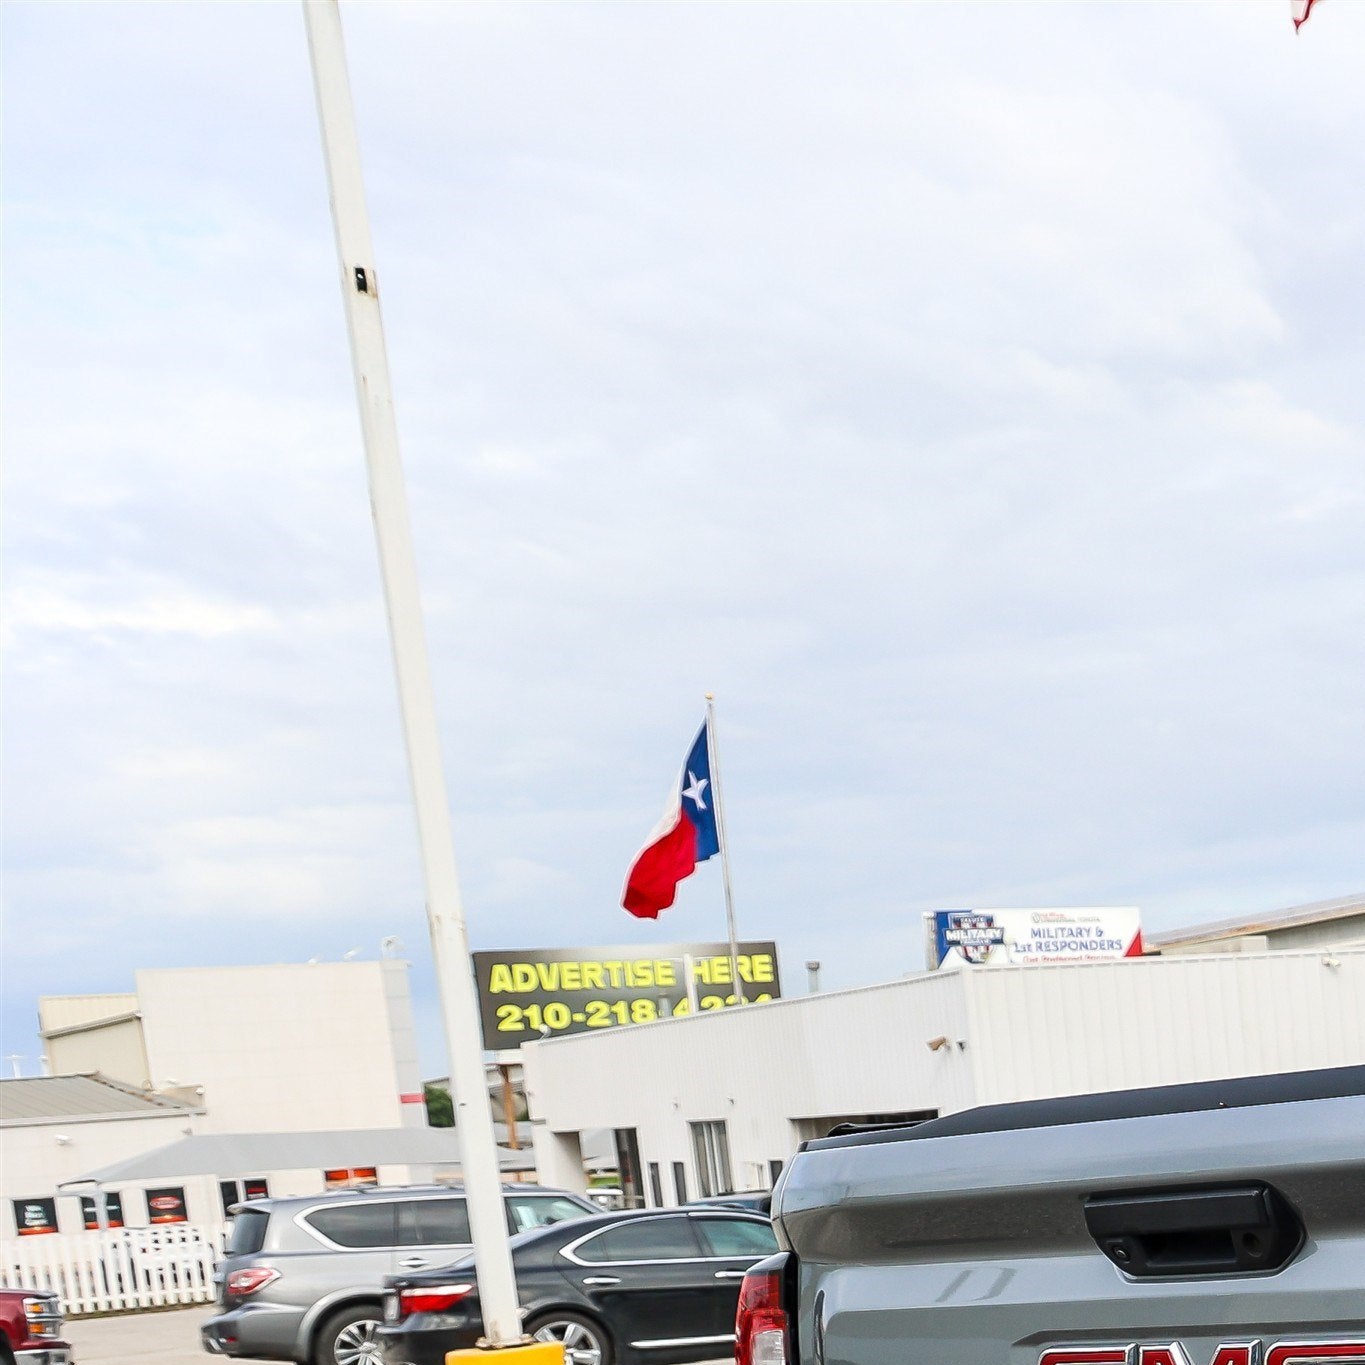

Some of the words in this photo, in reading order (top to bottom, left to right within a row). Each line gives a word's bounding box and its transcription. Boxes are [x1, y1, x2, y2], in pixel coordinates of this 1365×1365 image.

[945, 929, 1003, 941] MILITARY
[1030, 927, 1091, 939] MILITARY
[1095, 926, 1104, 938] &
[1014, 942, 1034, 954] 1st
[1036, 939, 1123, 952] RESPONDERS
[489, 959, 676, 993] ADVERTISE
[692, 954, 774, 984] HERE
